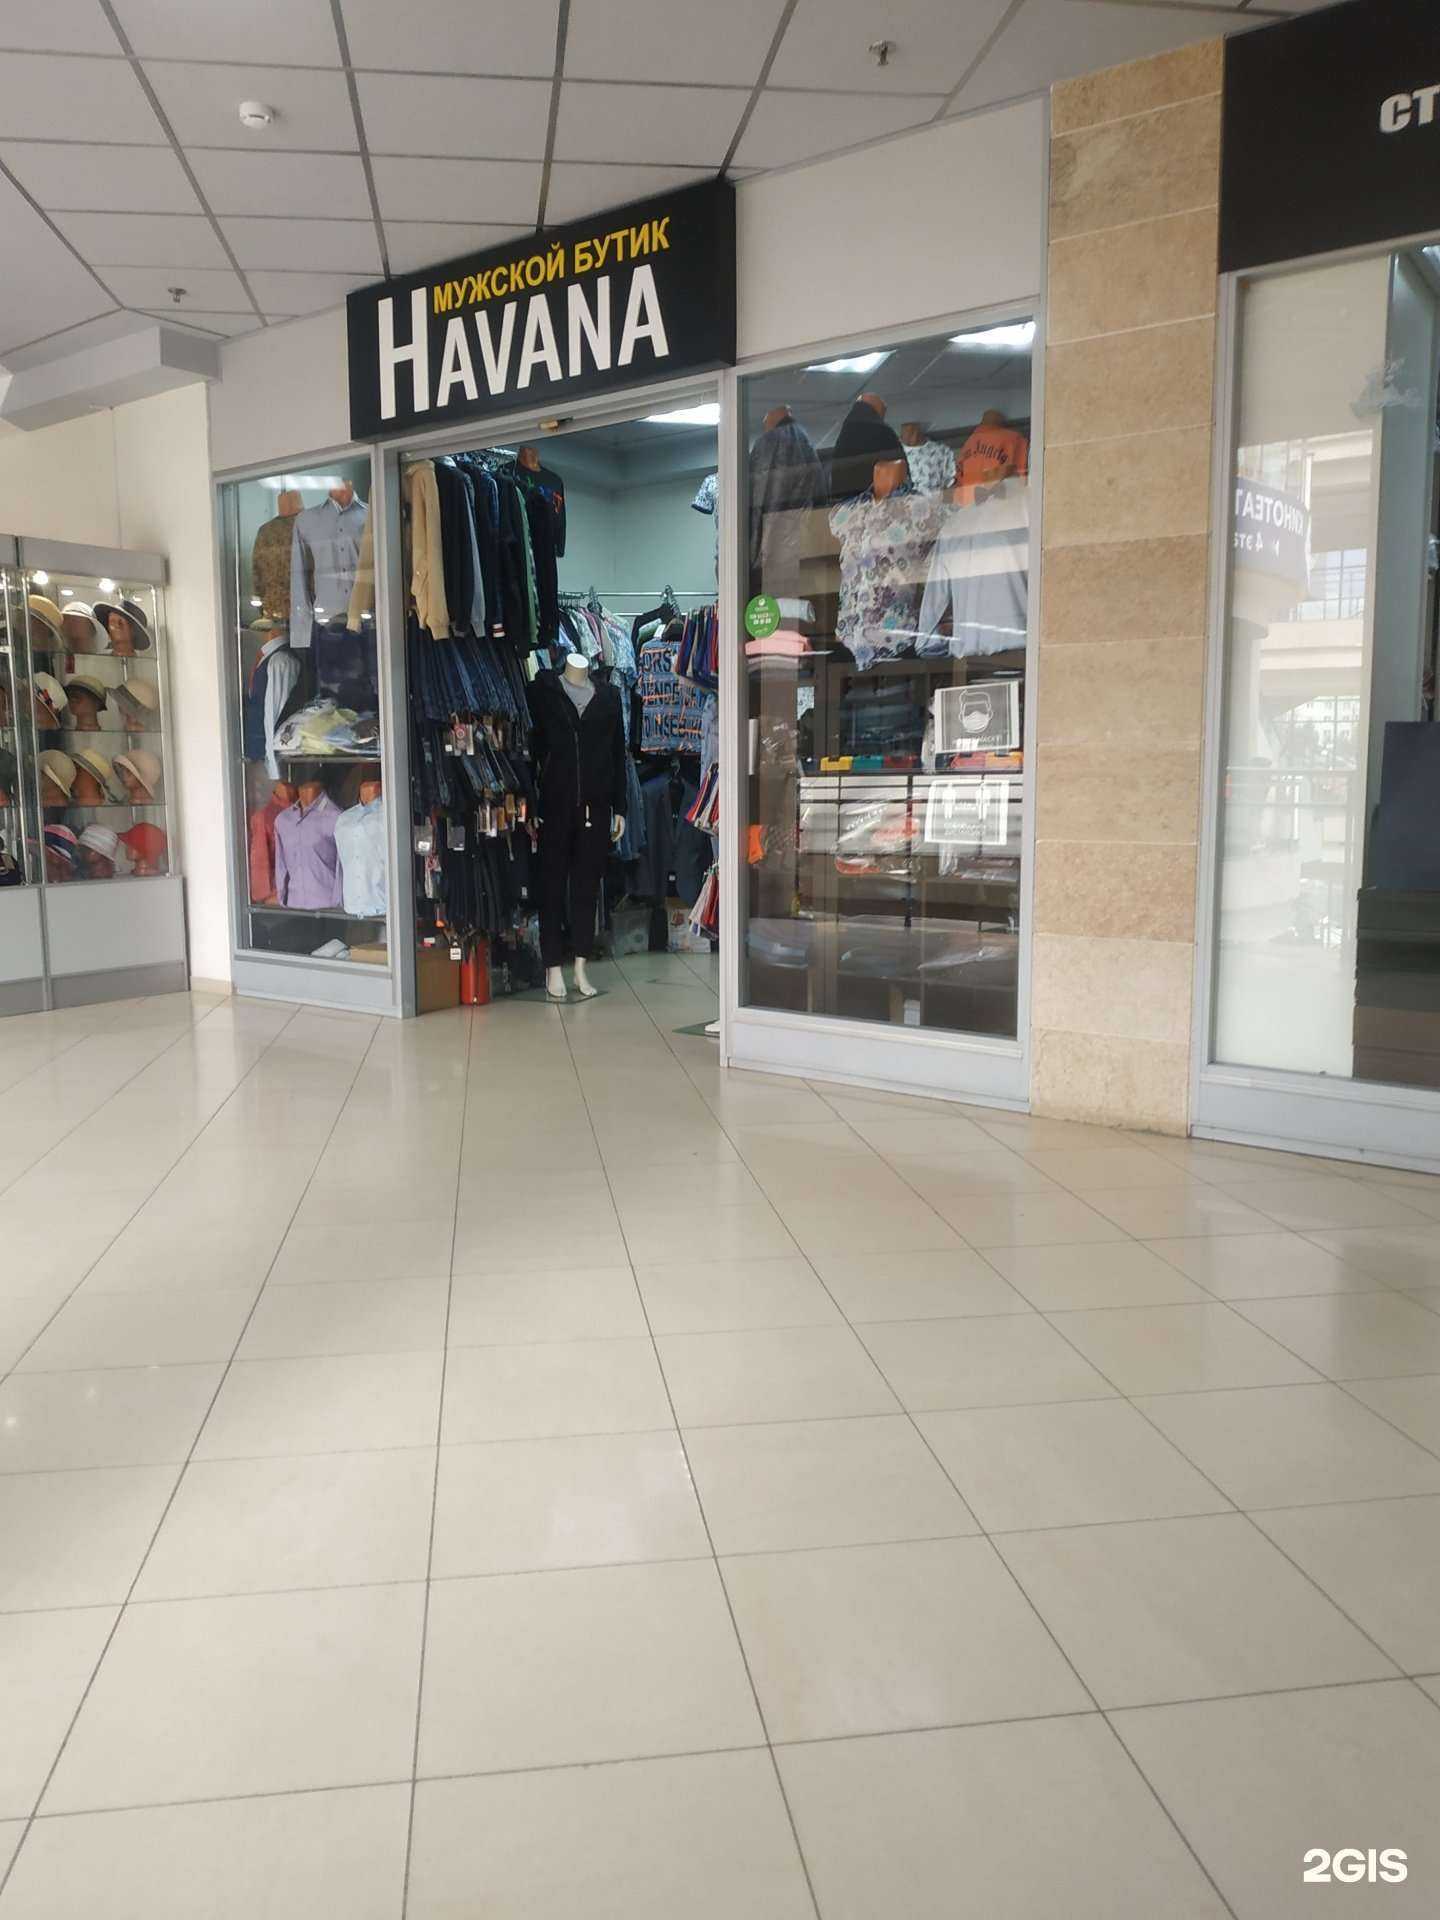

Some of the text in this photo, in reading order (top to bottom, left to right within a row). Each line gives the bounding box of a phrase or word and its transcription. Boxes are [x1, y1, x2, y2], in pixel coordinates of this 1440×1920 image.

[433, 216, 671, 314] МУЖСКОЙ БУТИК
[377, 263, 670, 421] HAVANA
